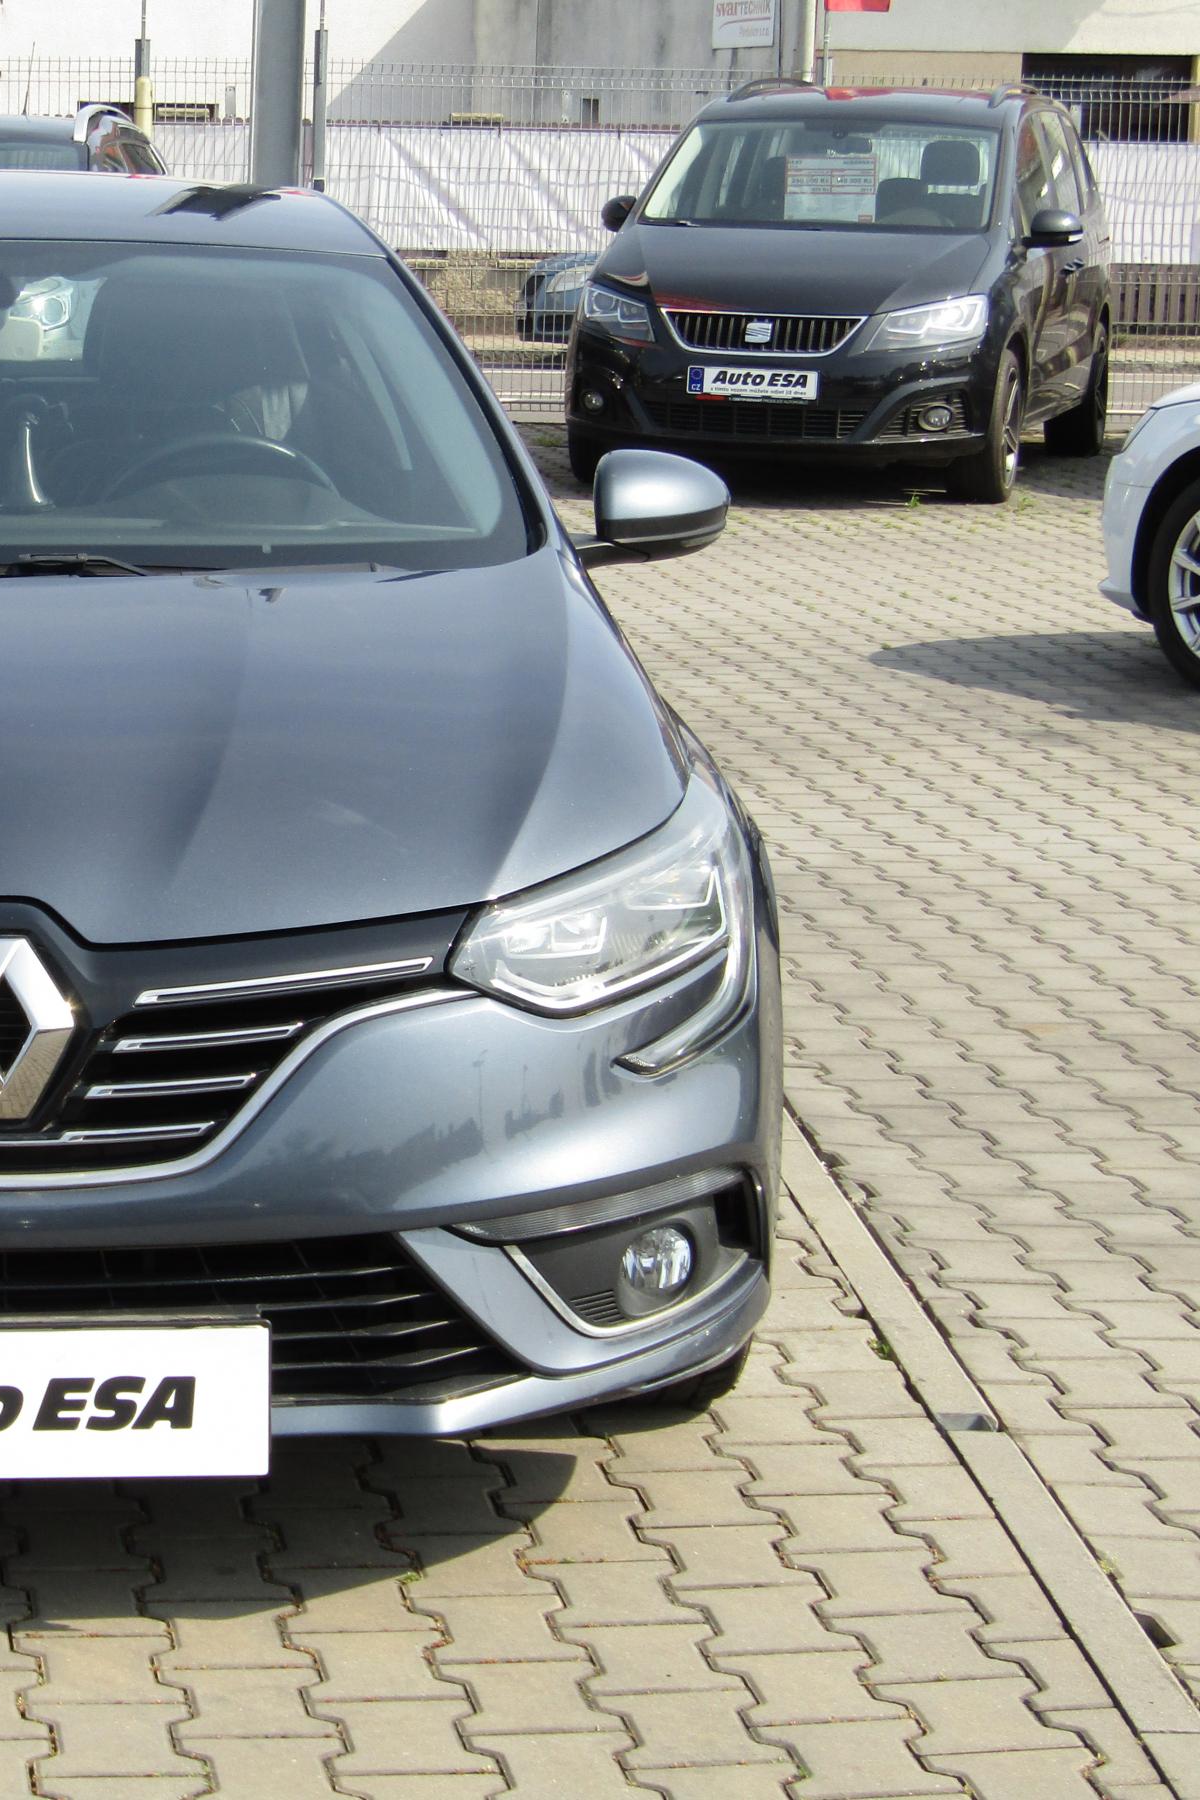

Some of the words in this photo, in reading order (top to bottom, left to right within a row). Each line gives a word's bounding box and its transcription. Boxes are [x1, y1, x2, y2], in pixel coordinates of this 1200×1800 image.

[712, 370, 765, 386] Auto
[767, 373, 808, 389] ESA
[32, 1375, 196, 1431] ESA
